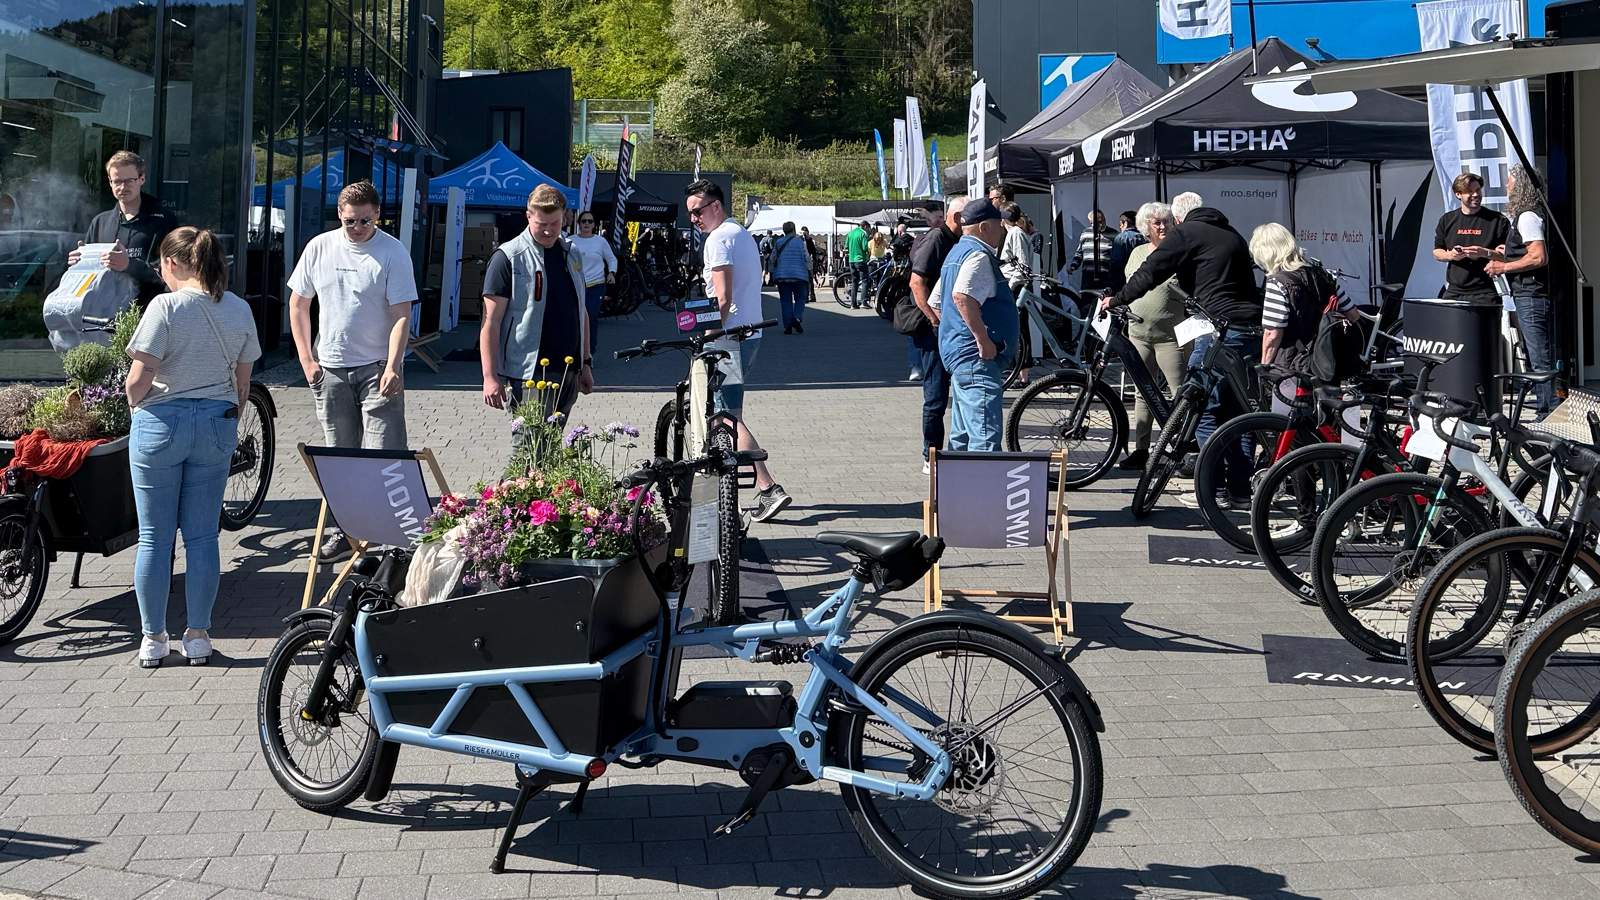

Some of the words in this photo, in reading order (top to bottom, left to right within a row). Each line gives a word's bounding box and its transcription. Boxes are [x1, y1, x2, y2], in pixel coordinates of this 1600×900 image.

[1111, 134, 1134, 162] HEPHA
[1193, 129, 1289, 152] HEPHA
[1403, 335, 1465, 354] RAYMON
[1293, 672, 1467, 690] RAYMN
